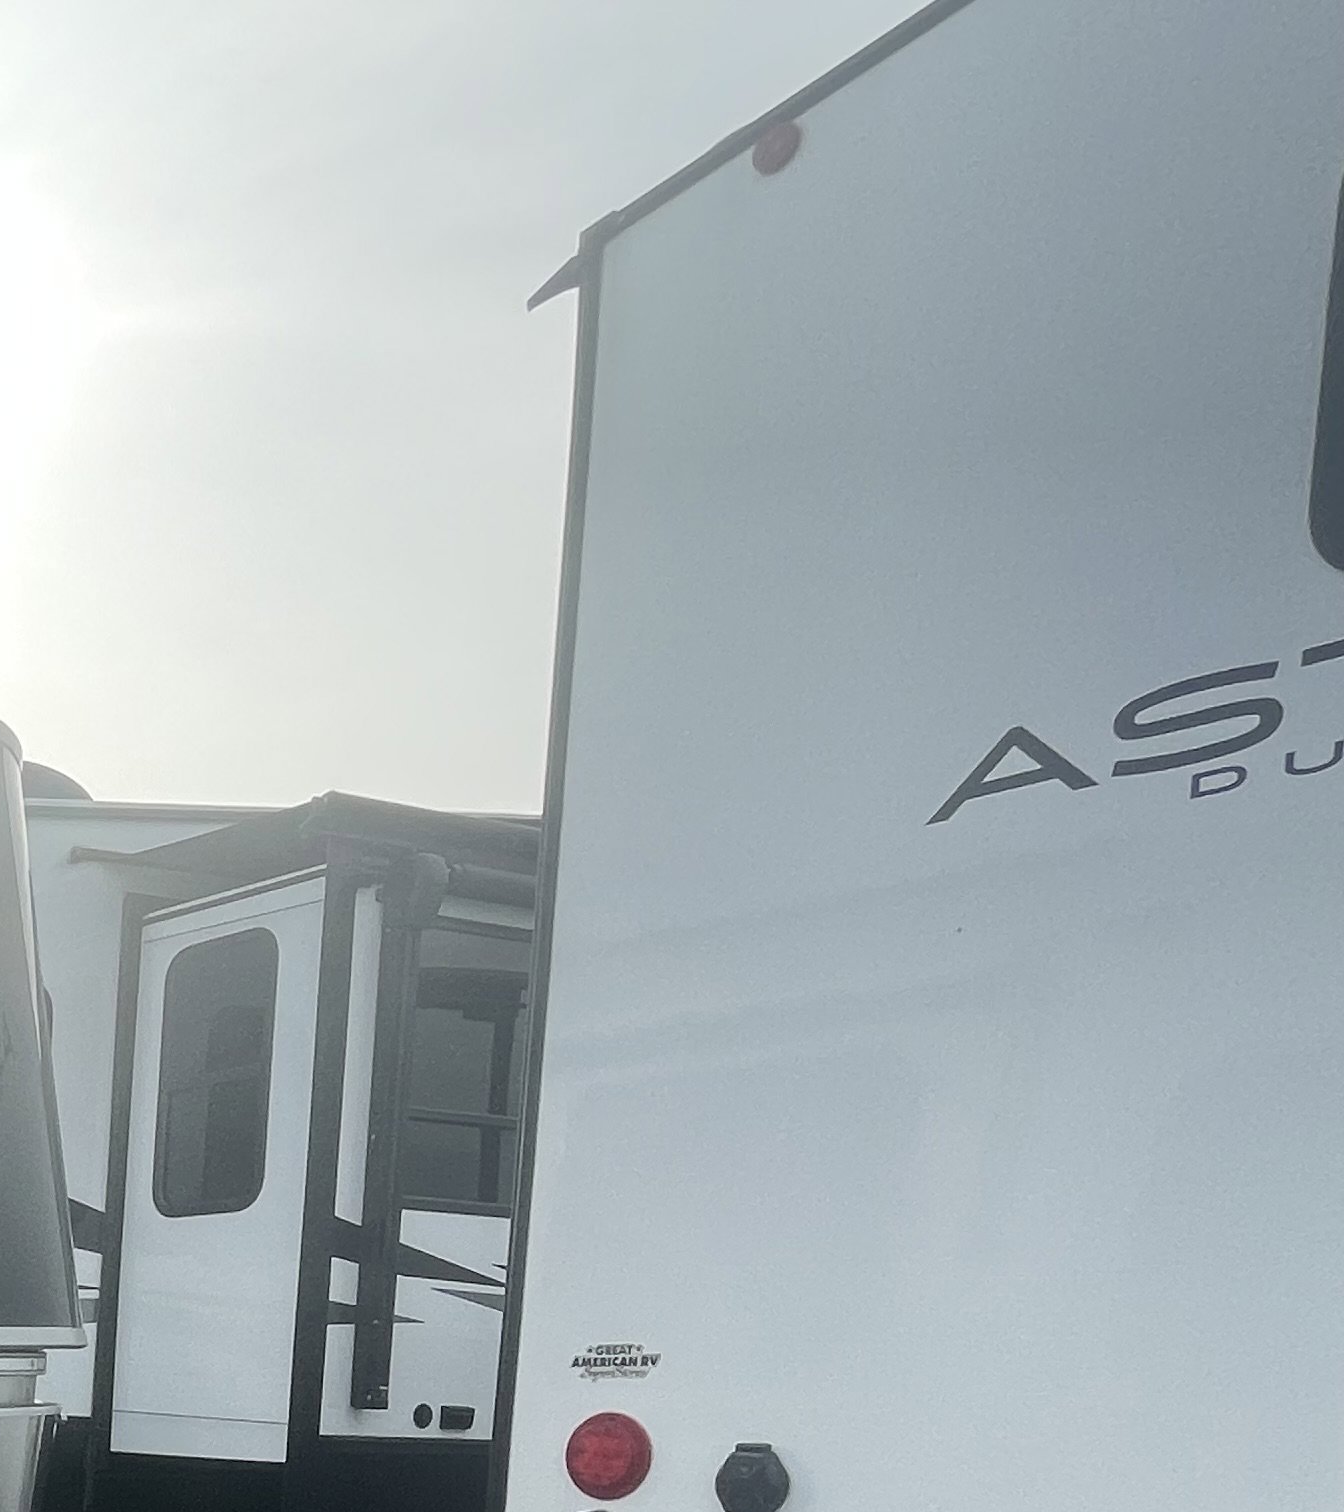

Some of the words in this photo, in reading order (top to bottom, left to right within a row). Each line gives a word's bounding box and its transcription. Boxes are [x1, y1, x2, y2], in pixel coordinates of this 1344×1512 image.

[595, 1344, 634, 1356] GREAT
[570, 1356, 638, 1368] AMERICAN
[640, 1355, 659, 1367] RV
